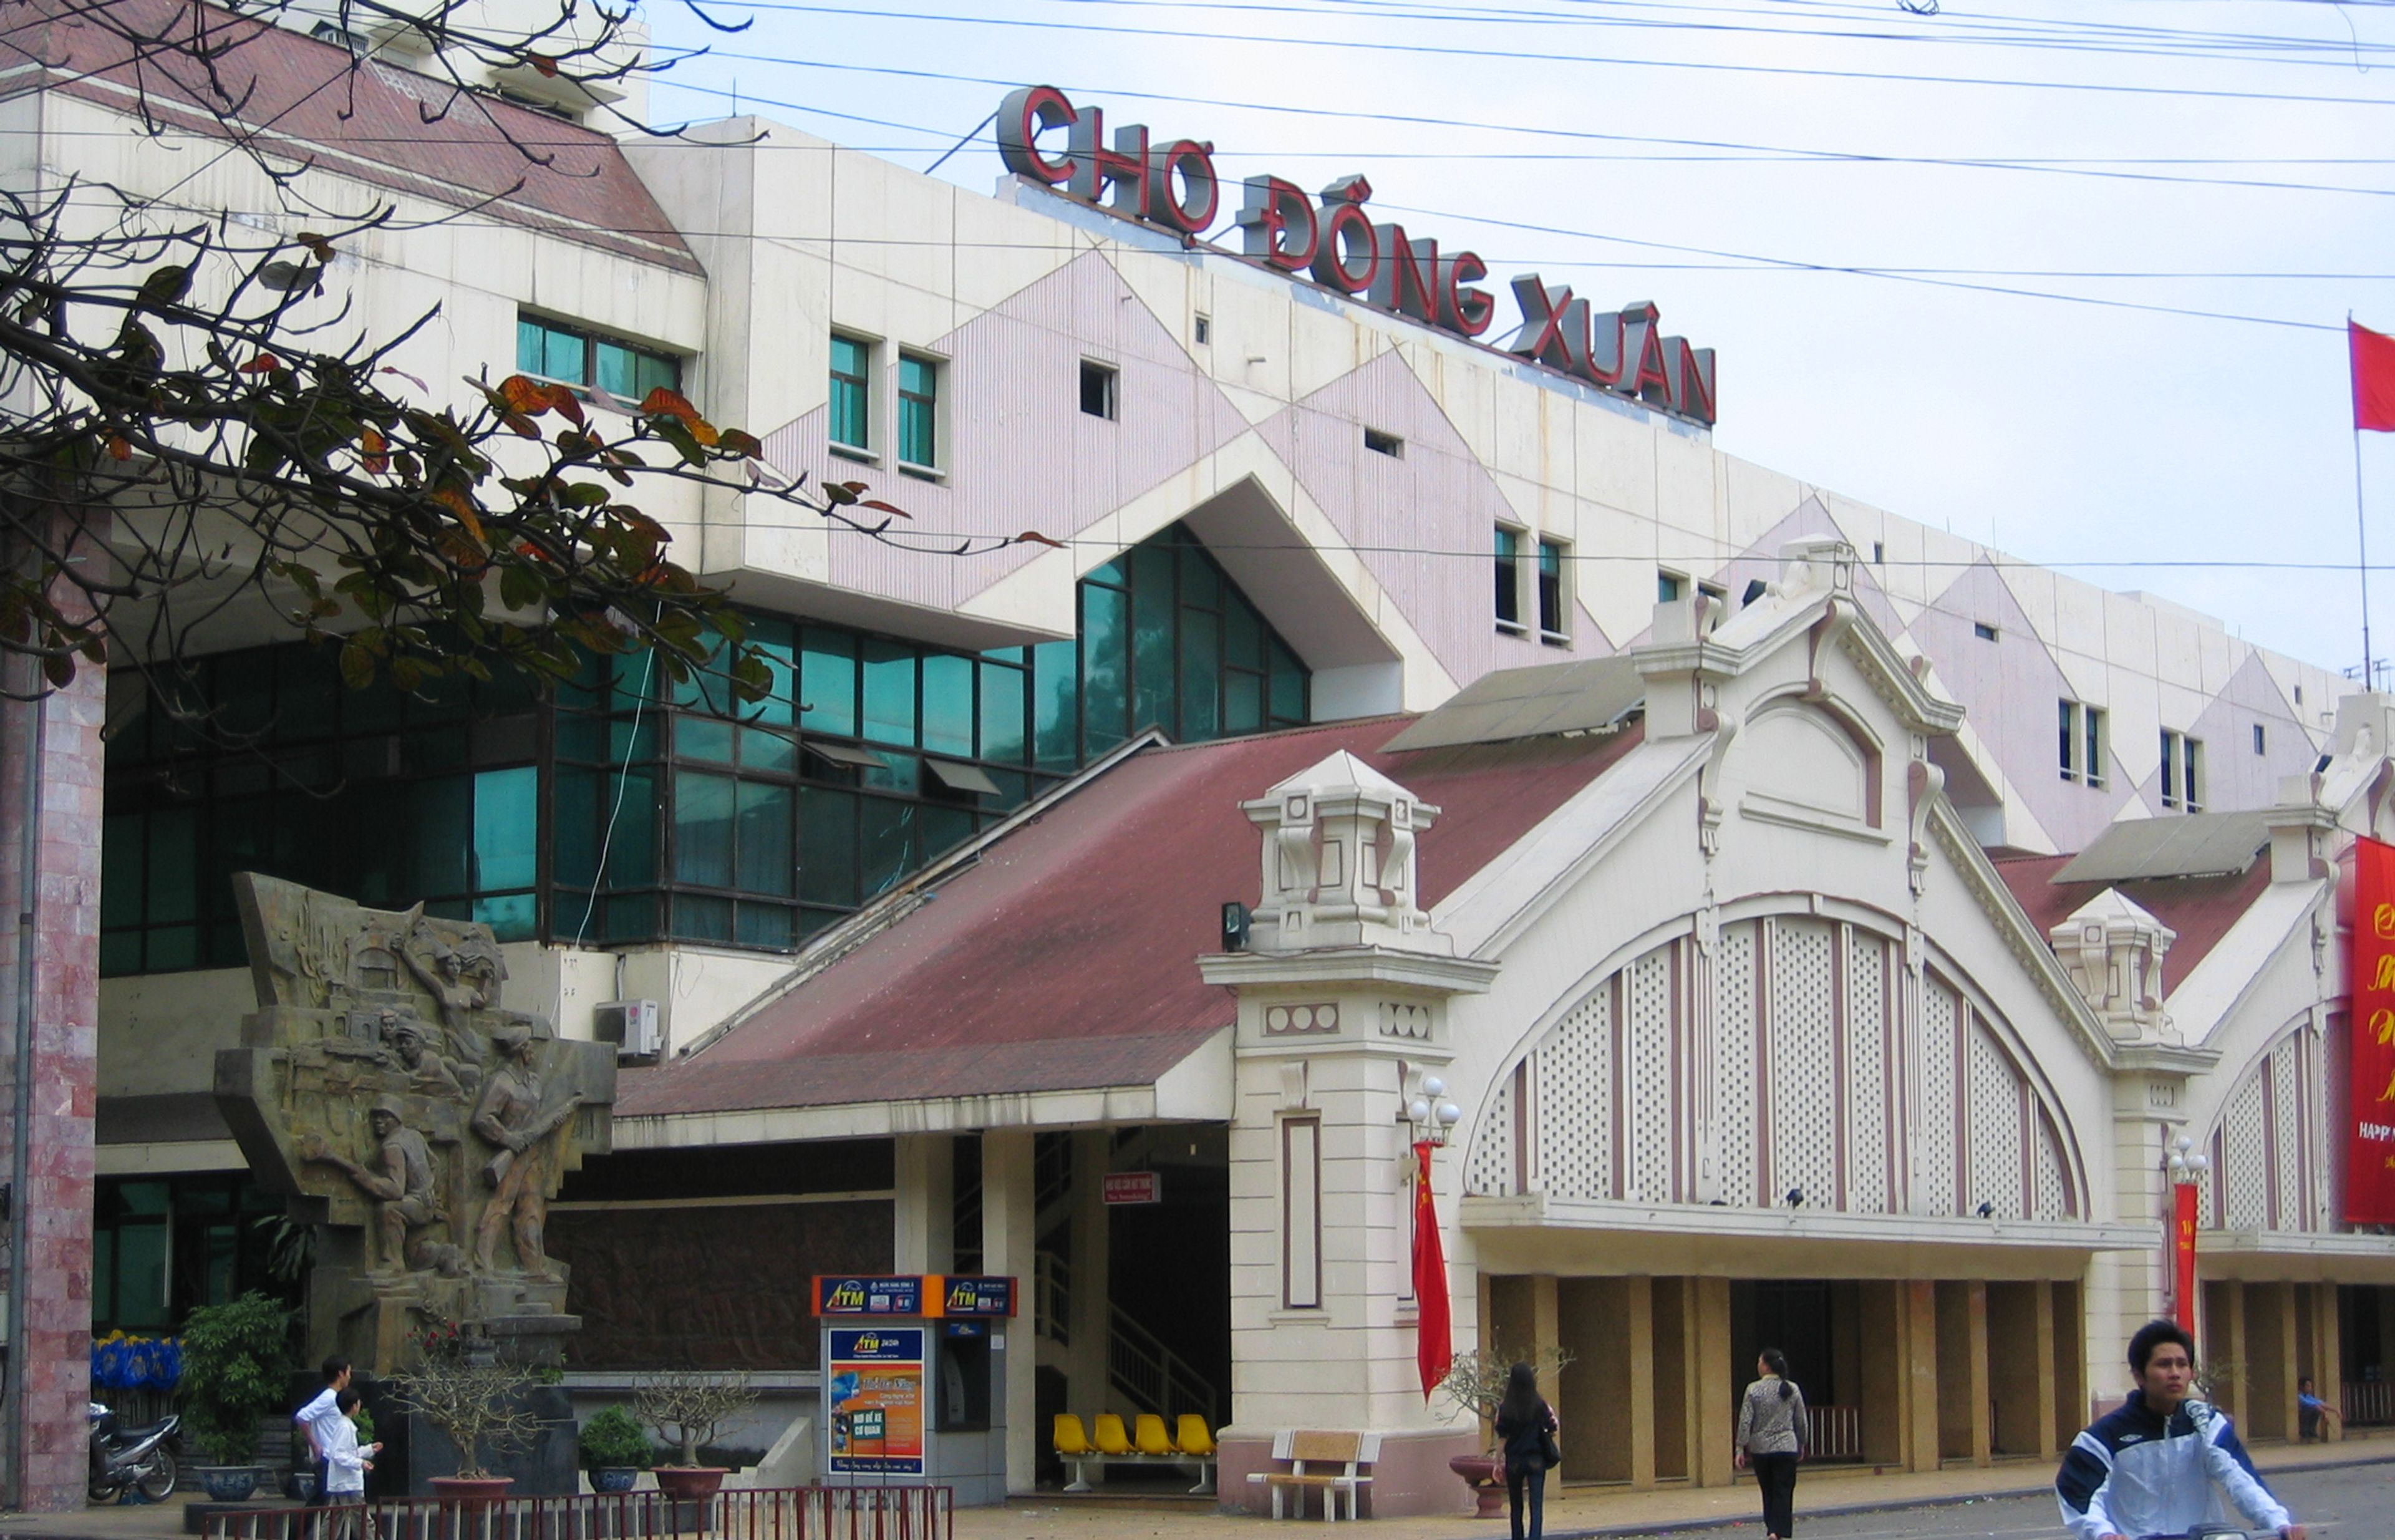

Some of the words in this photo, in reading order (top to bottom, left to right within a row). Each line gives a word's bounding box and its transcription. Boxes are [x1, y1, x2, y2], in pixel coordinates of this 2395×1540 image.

[997, 84, 1219, 250] CHỢ
[1509, 272, 1716, 425] XUÂN
[826, 1284, 865, 1308] ATM
[947, 1285, 977, 1307] ATM
[853, 1334, 879, 1350] ATM
